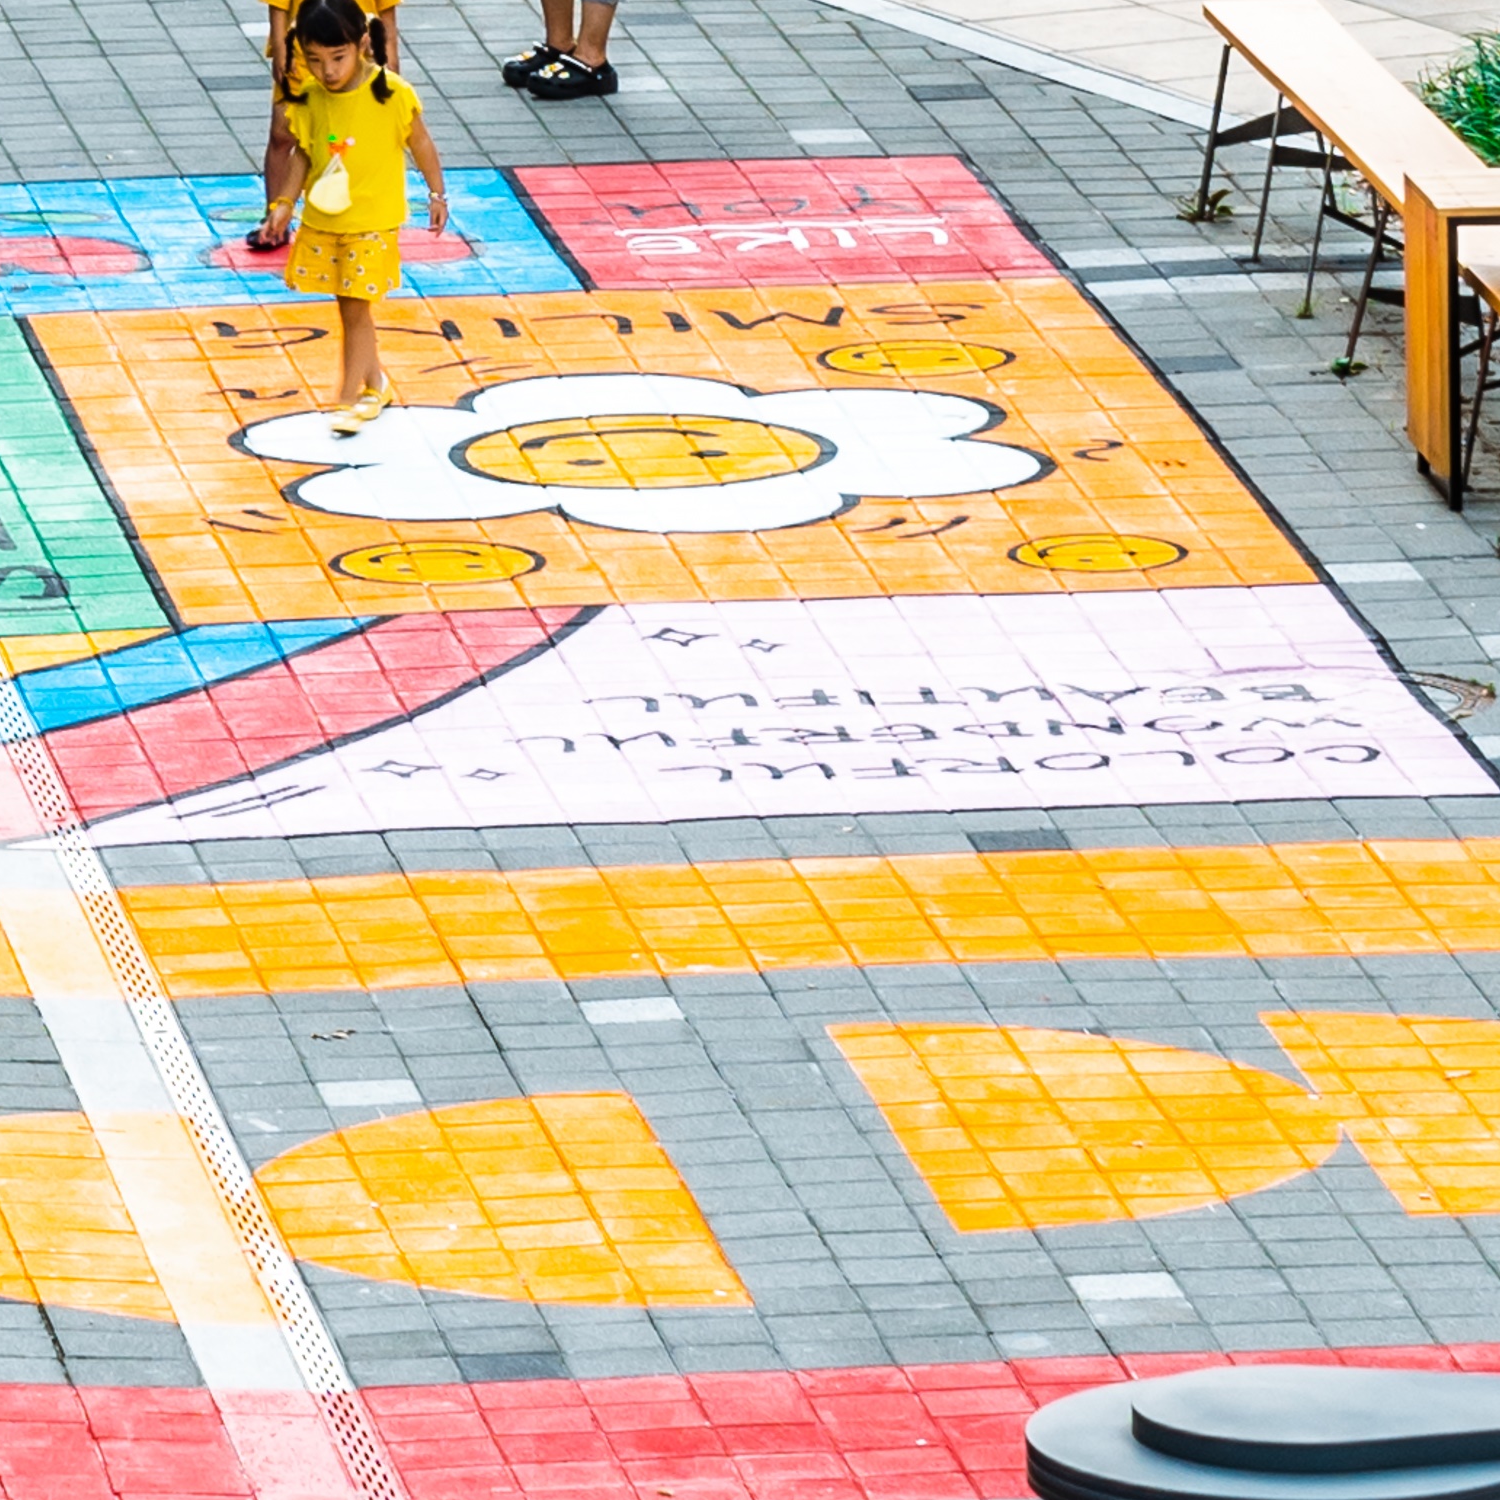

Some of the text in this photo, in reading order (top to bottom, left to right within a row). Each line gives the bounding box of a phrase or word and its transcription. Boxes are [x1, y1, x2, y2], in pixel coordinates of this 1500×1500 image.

[626, 225, 949, 256] LIKE
[583, 683, 1322, 715] BEAUTIFUL
[506, 713, 1364, 755] WONDERFUL
[658, 743, 1383, 783] COLORFUL
